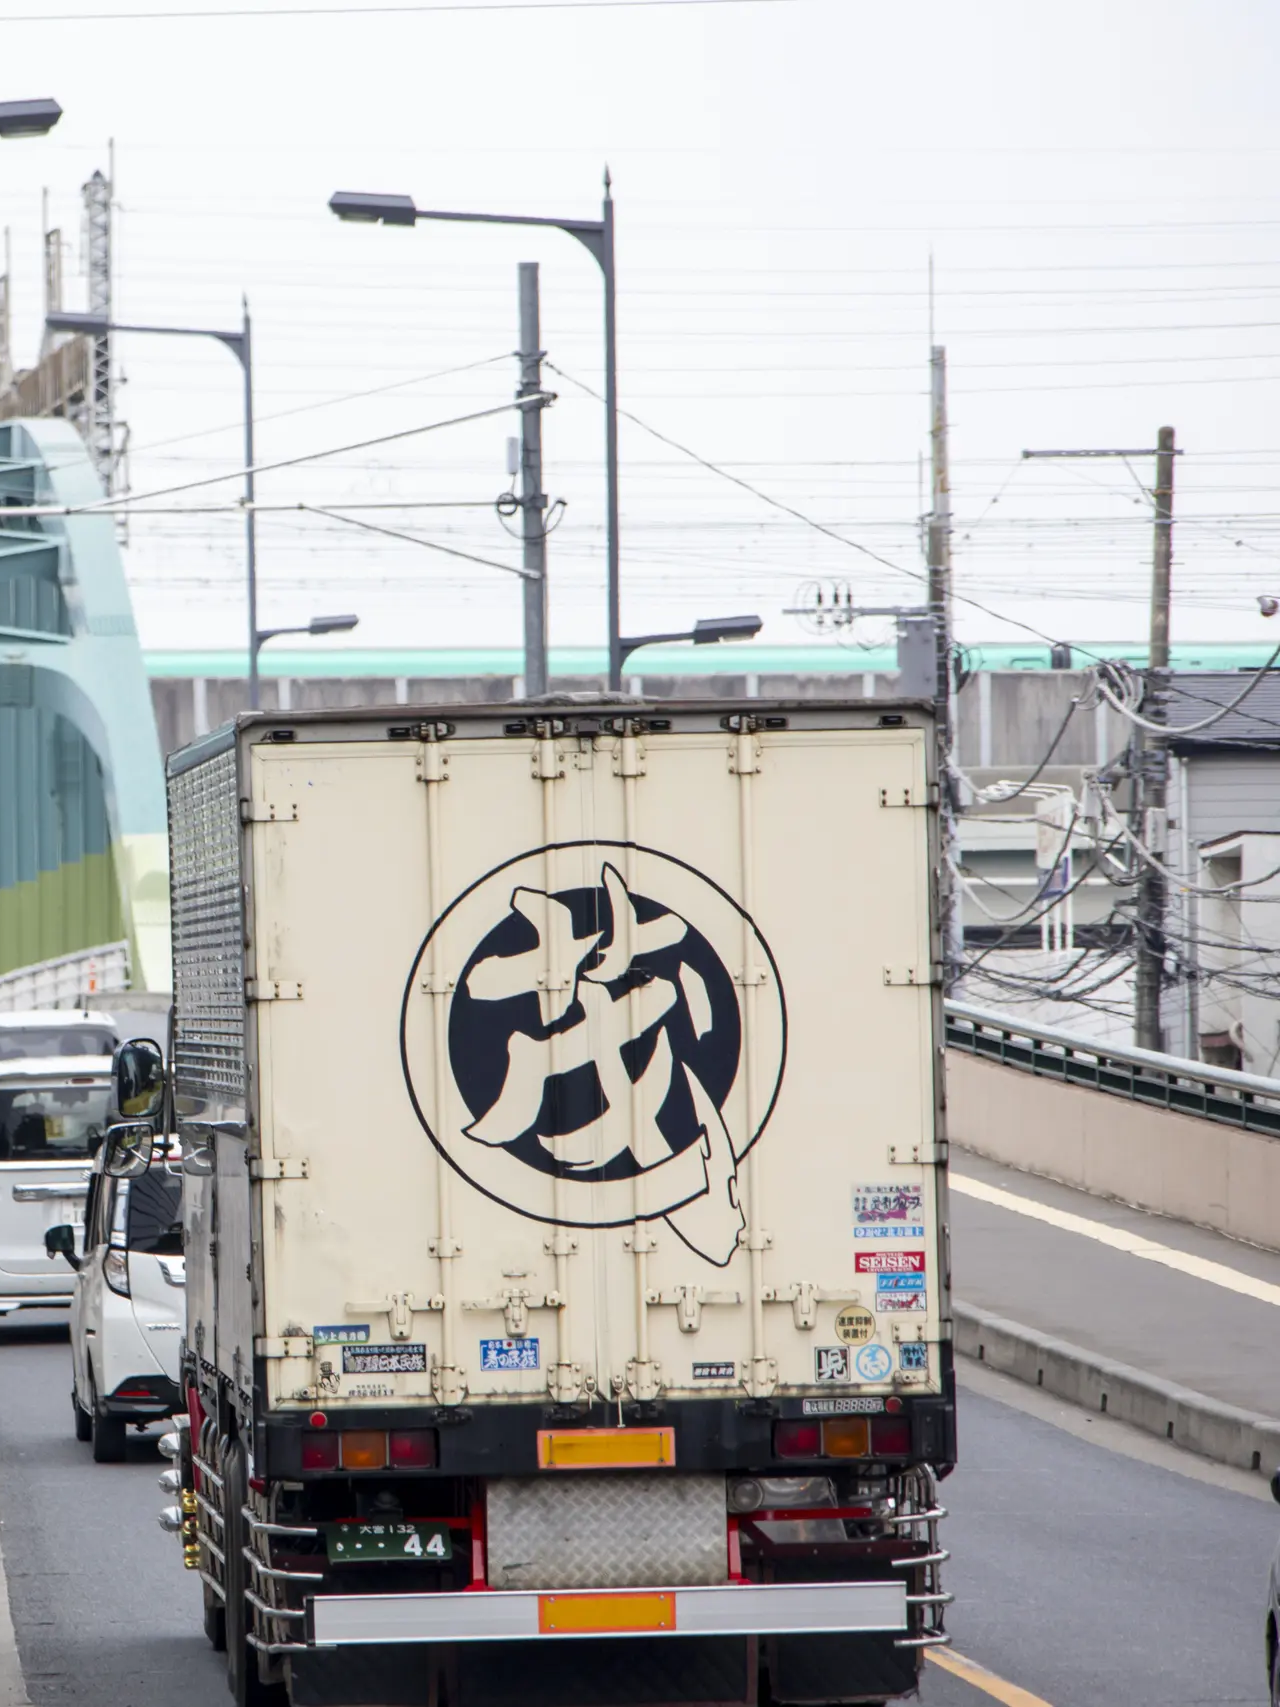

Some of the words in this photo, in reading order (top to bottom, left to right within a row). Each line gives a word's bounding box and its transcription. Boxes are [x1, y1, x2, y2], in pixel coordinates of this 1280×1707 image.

[858, 1255, 921, 1269] SEISEN
[359, 1525, 385, 1534] 大宮
[389, 1524, 416, 1534] 132
